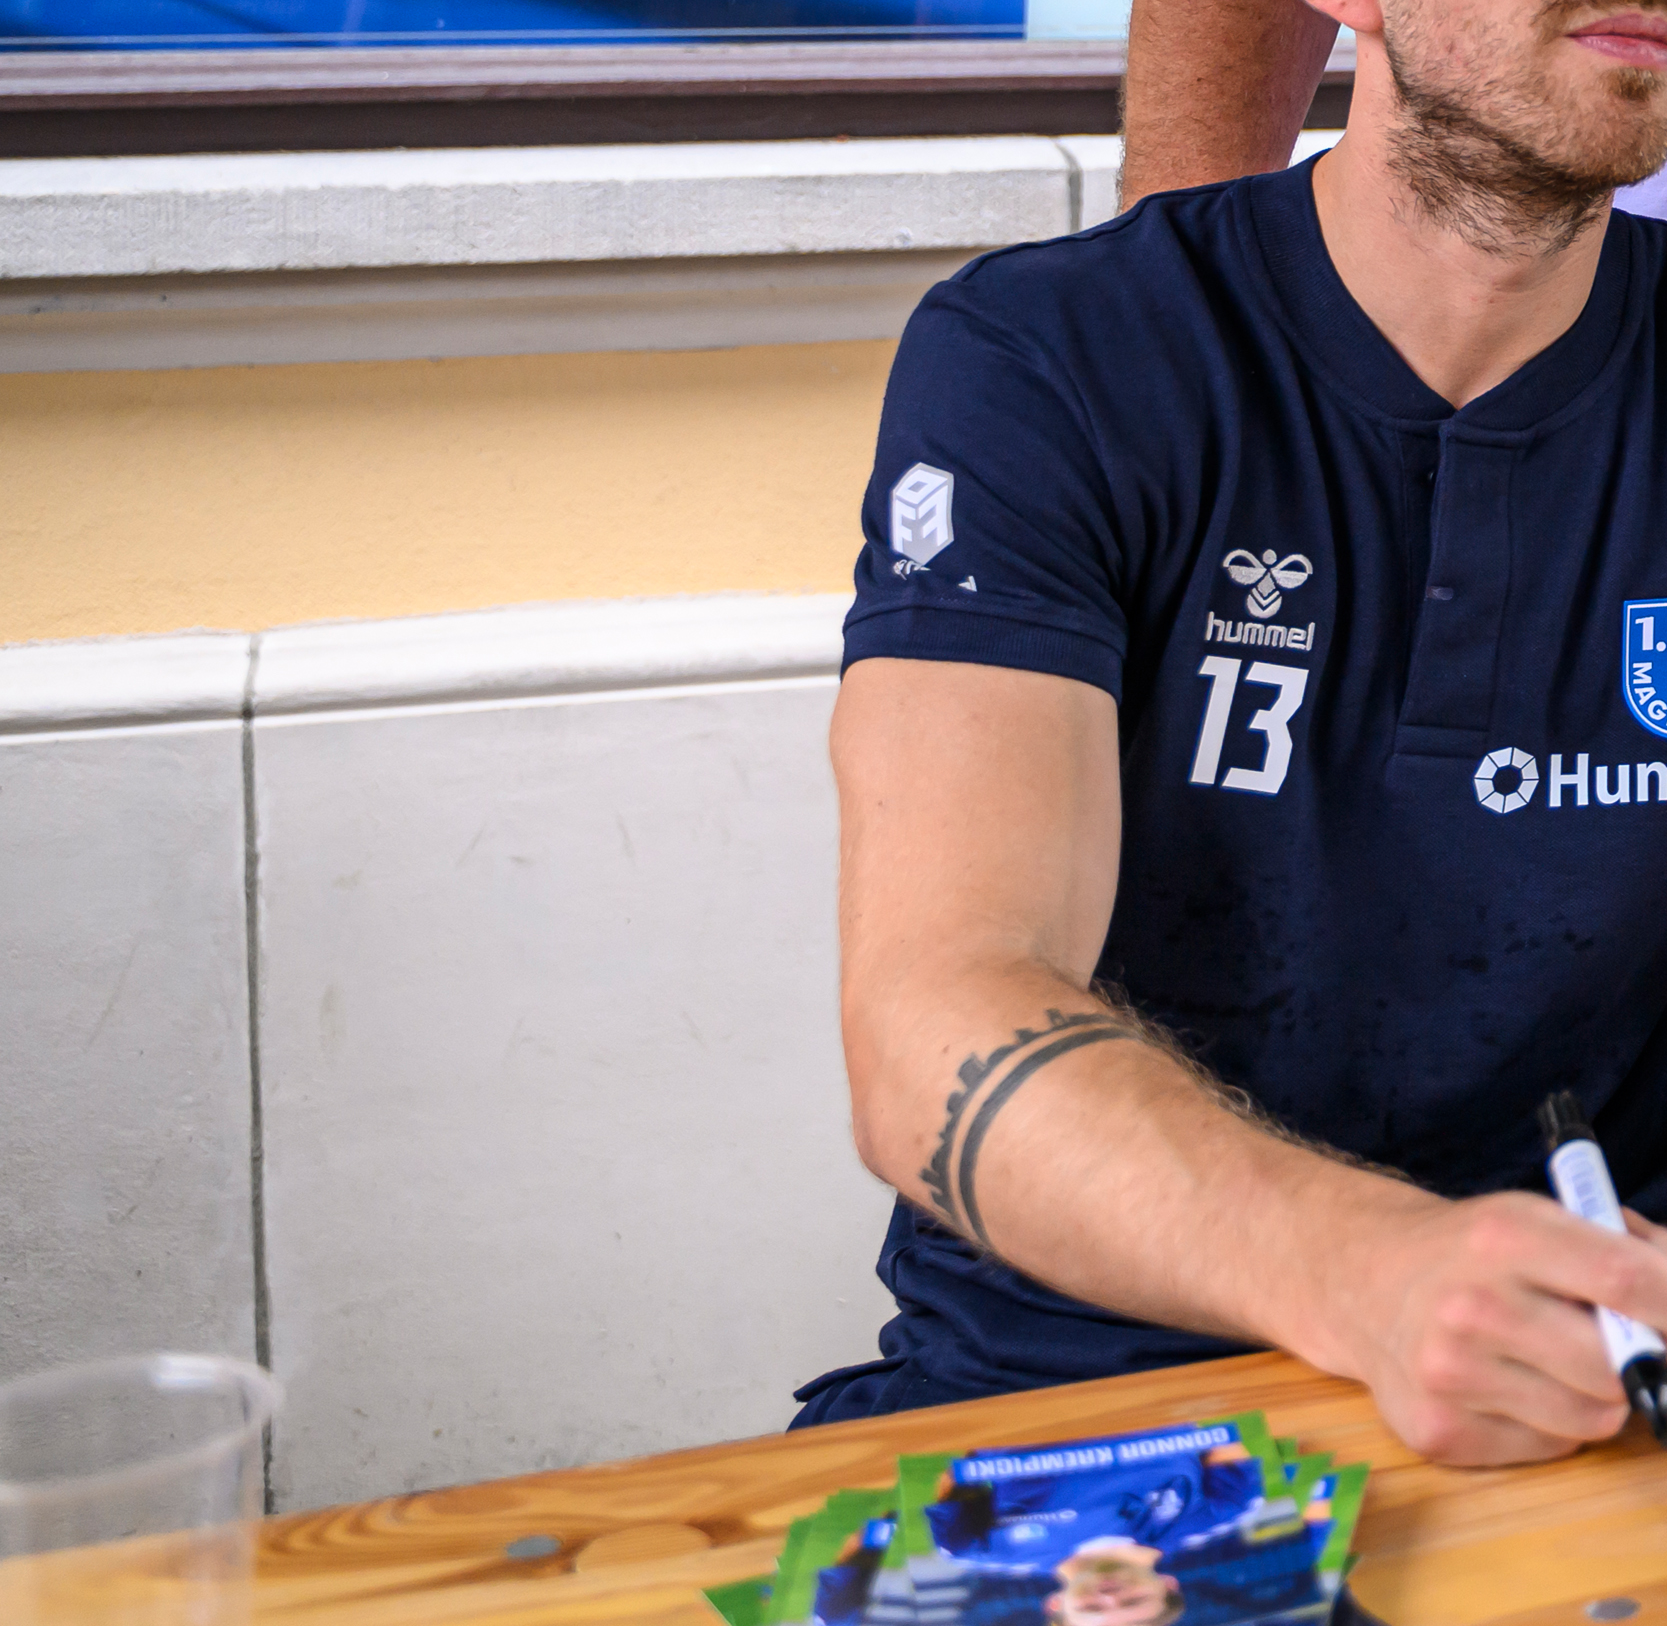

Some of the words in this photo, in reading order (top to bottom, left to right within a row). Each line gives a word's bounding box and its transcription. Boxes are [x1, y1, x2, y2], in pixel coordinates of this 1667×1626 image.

[1204, 610, 1316, 652] hummel
[1189, 655, 1310, 795] 13
[1115, 1426, 1230, 1461] CONNOR
